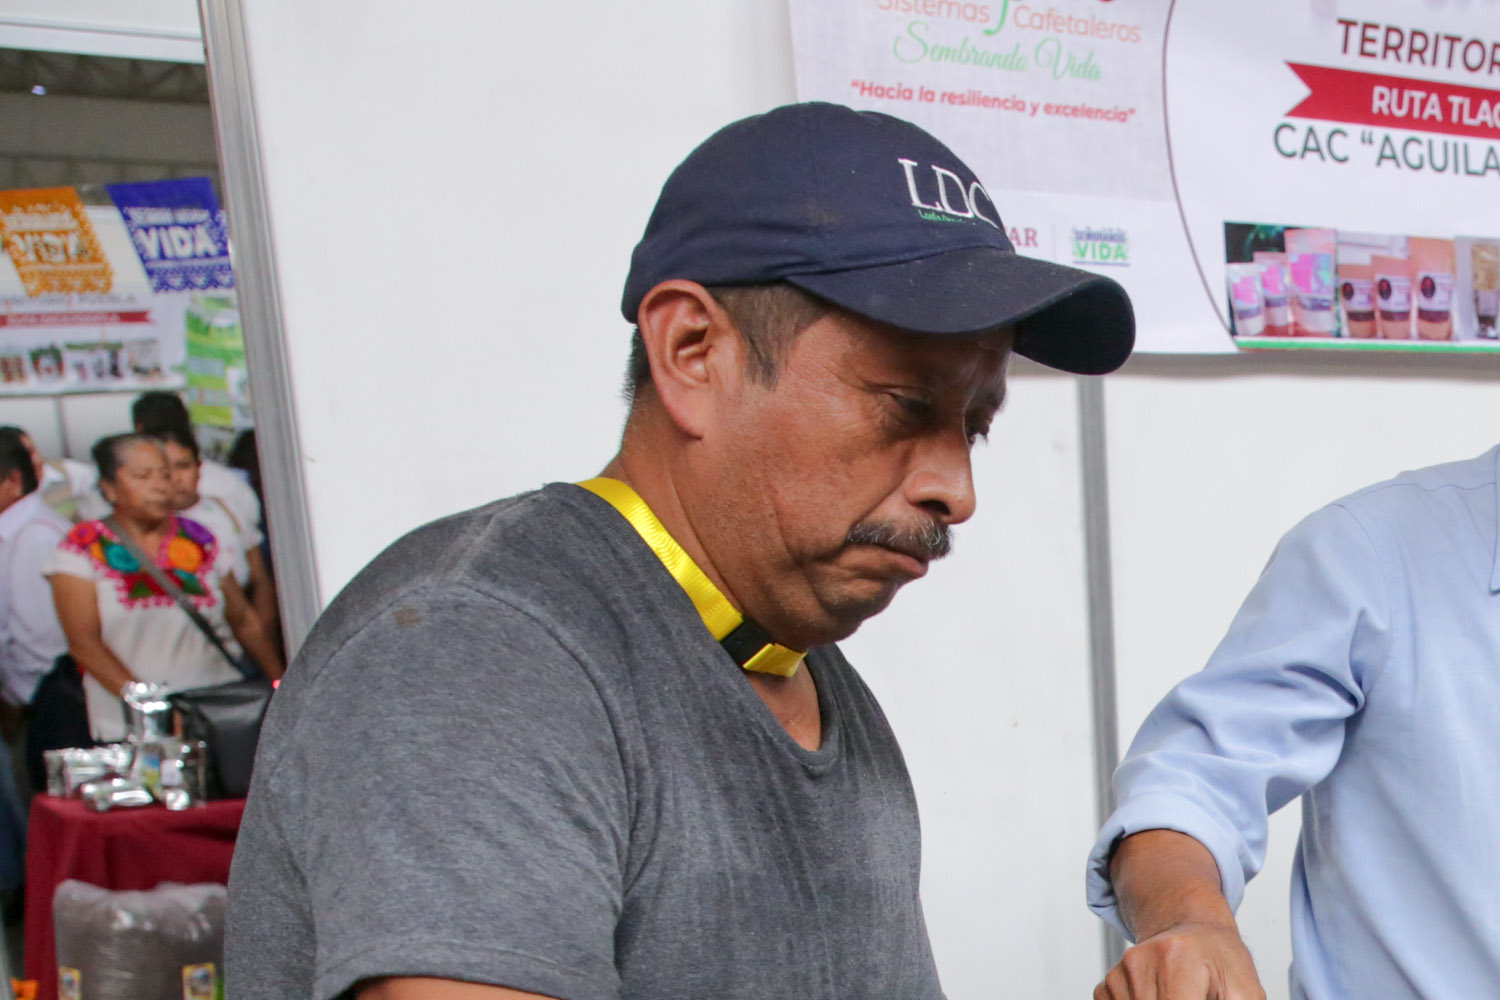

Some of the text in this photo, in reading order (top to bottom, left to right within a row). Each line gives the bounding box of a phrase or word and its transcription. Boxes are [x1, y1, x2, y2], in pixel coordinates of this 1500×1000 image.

[1013, 5, 1141, 43] Cafetaleros
[892, 20, 1101, 80] Sembrando Vida
[919, 86, 935, 103] la
[940, 92, 1026, 112] resiliencia
[1030, 101, 1038, 117] y
[1371, 85, 1443, 122] RUTA
[1273, 122, 1350, 163] CAC
[134, 223, 219, 261] VIDA
[1075, 242, 1128, 260] VIDA
